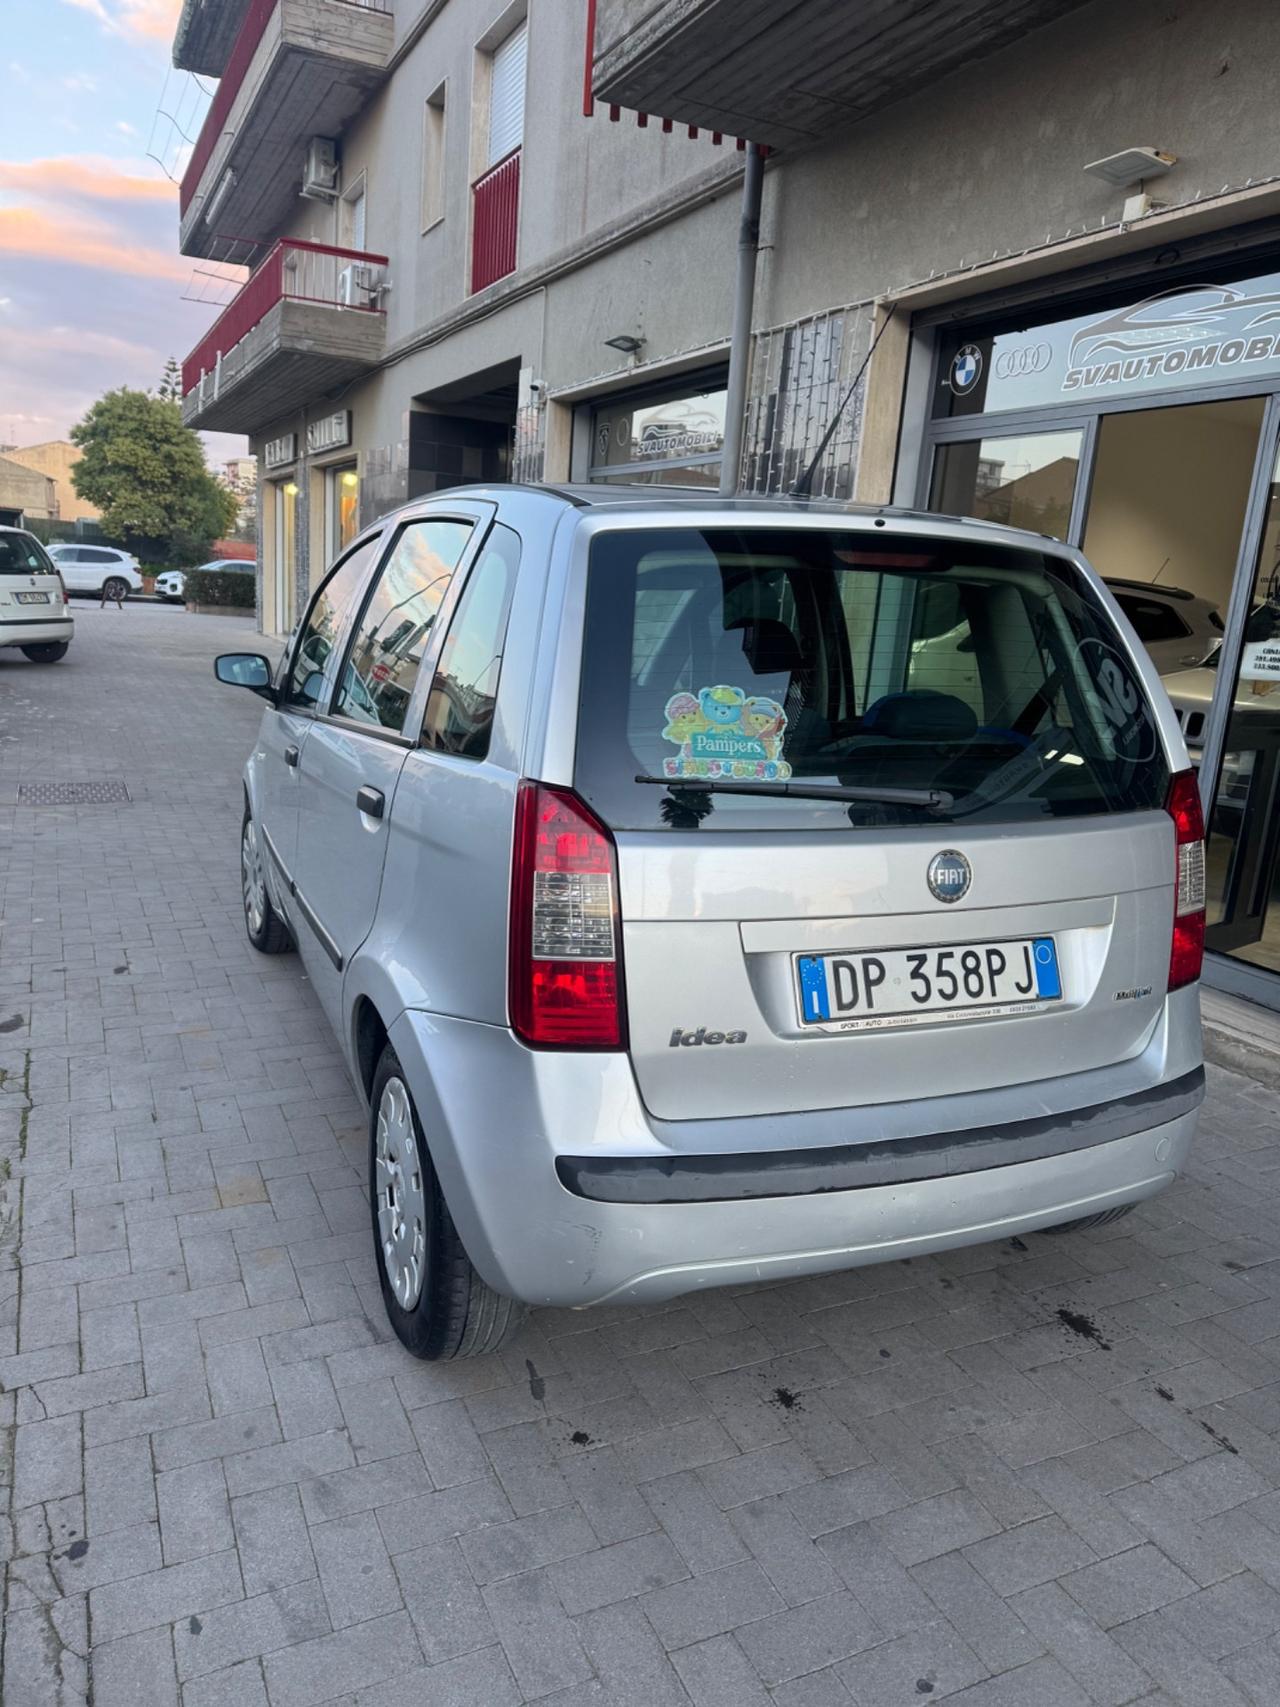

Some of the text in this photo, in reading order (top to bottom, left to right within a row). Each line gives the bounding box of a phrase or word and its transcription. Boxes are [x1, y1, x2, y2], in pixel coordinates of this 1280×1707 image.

[636, 430, 718, 456] SVAUTOMOBILI
[696, 735, 761, 755] Pampers
[937, 868, 965, 885] FIAT
[832, 957, 886, 1012] DP
[906, 945, 1034, 1004] 358PJ
[840, 1021, 860, 1030] SPORT
[865, 1018, 882, 1027] AUTO
